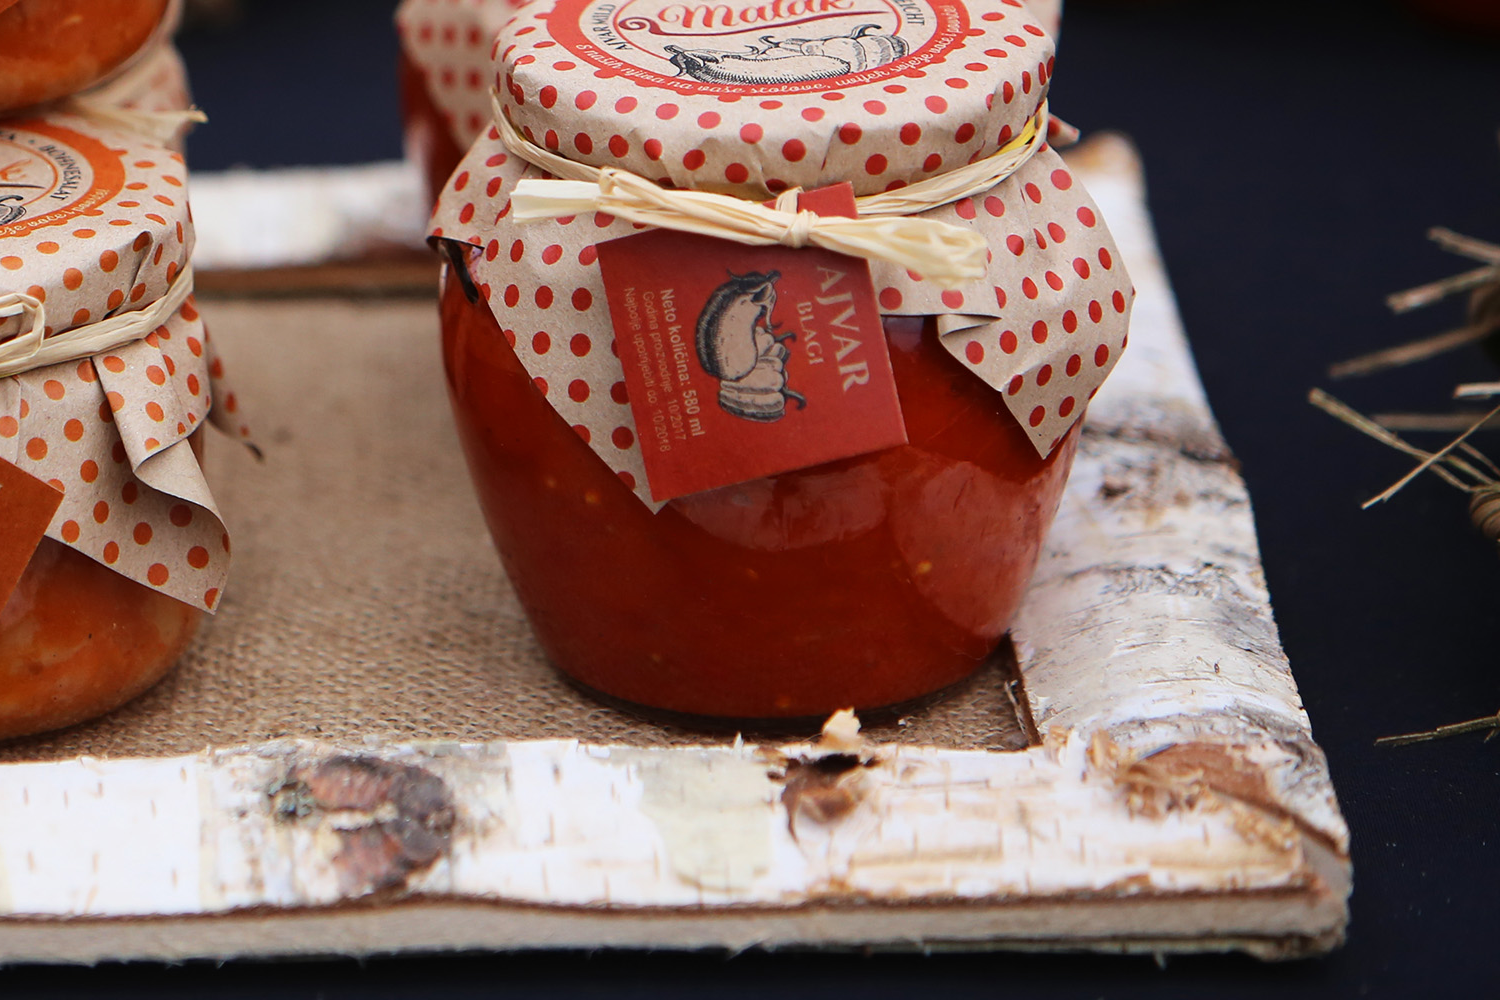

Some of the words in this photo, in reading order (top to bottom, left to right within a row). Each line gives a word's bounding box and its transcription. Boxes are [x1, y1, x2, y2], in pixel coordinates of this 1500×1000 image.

[593, 26, 633, 50] AJVAR
[584, 48, 622, 69] naših
[621, 67, 665, 84] njiva
[668, 79, 693, 90] na
[747, 83, 831, 94] stolove,
[835, 70, 890, 86] uvijek
[661, 289, 677, 323] Neto
[815, 265, 870, 393] AJVAR
[668, 325, 691, 386] količina:
[796, 302, 824, 365] BLAGI
[623, 287, 641, 331] Najbolje
[653, 409, 671, 453] 10/2018
[643, 291, 659, 331] Godina
[668, 399, 687, 441] 10/2017
[683, 389, 700, 415] 580
[689, 415, 706, 437] ml
